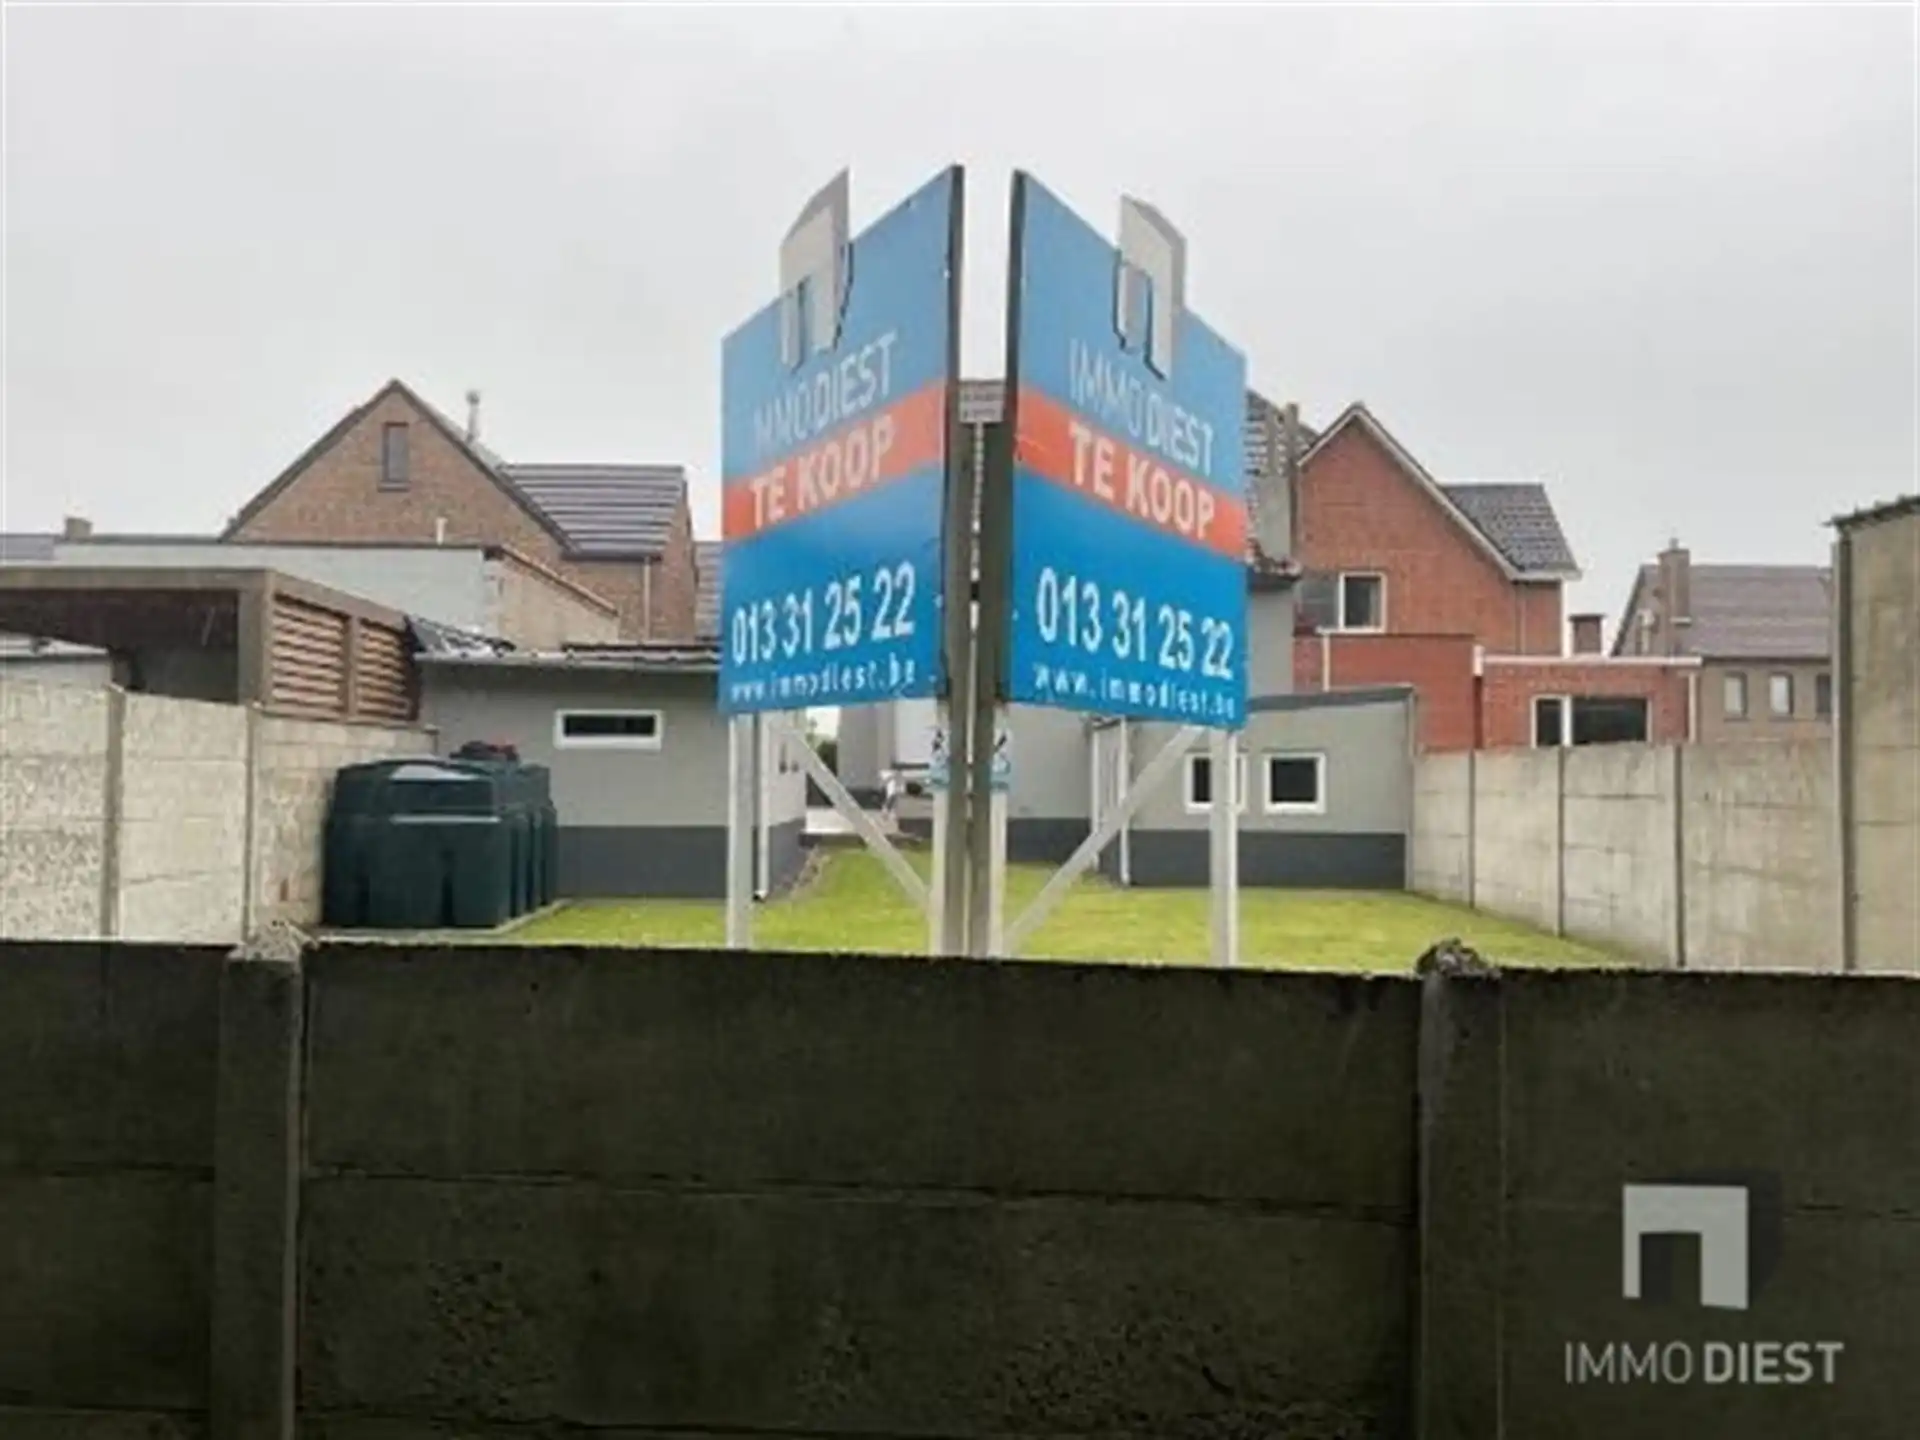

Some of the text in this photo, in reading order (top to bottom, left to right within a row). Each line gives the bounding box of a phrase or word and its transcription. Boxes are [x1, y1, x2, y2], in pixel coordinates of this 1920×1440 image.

[813, 331, 896, 436] DIEST
[1147, 391, 1214, 477] DIEST
[750, 413, 897, 528] TE KOOP
[1068, 420, 1215, 540] TE KOOP
[731, 560, 916, 668] 013 31 25 22
[1036, 565, 1235, 681] 013 31 25 22
